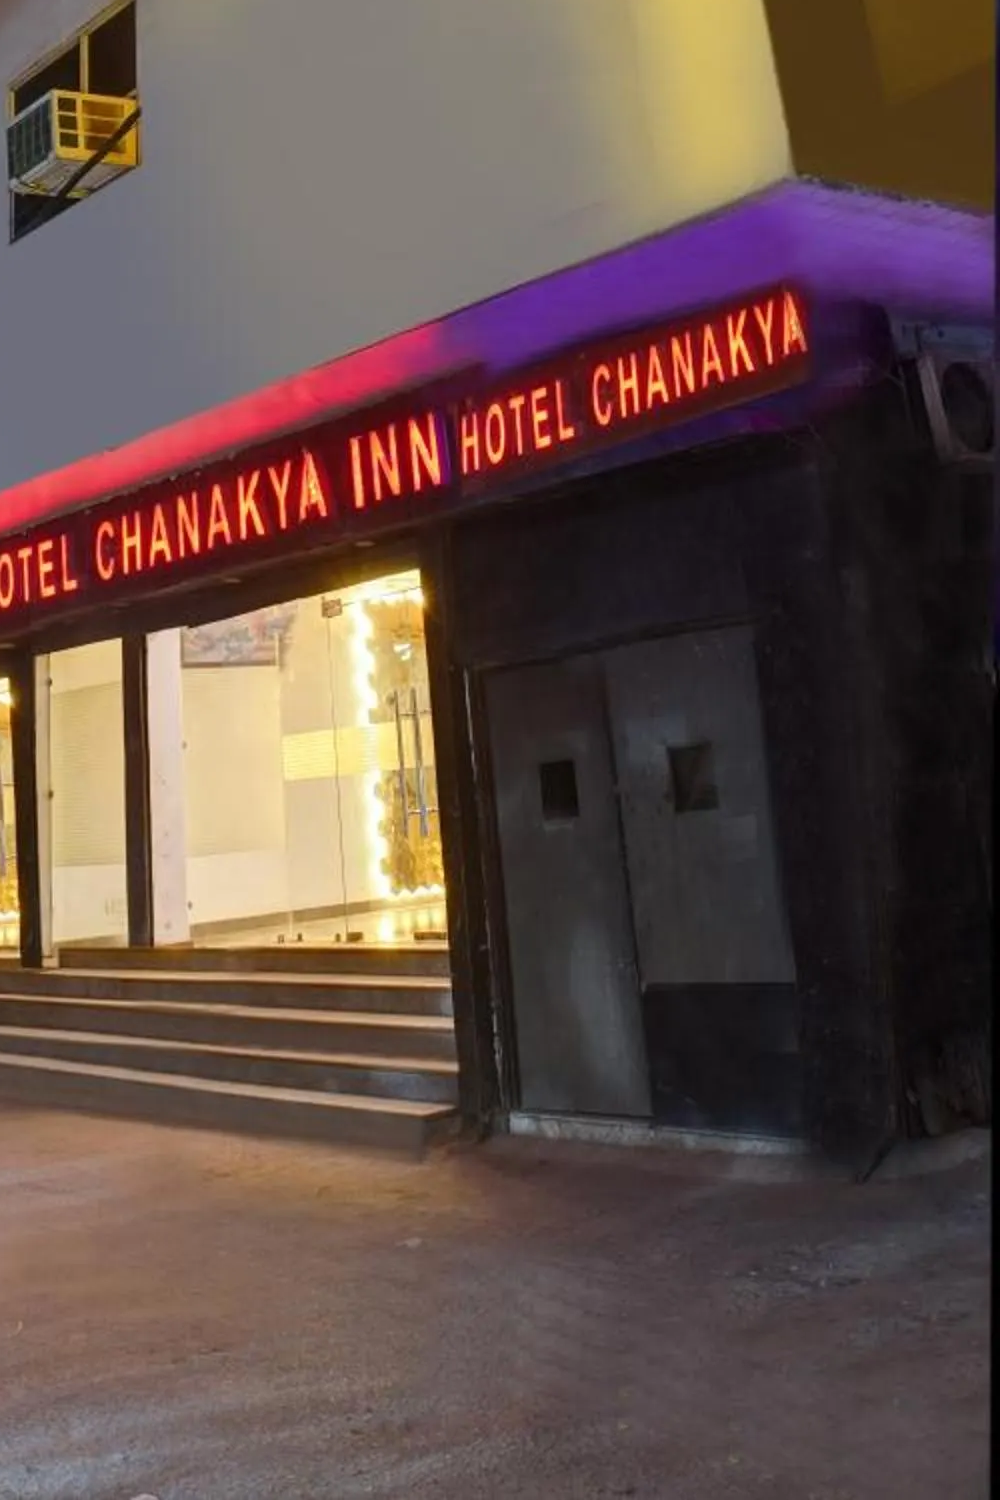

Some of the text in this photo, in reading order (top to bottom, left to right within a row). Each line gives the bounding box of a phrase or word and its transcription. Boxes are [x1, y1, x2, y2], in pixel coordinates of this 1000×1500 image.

[460, 290, 808, 477] HOTEL CHANAKYA
[95, 449, 328, 582] CHANAKYA
[349, 411, 442, 509] INN
